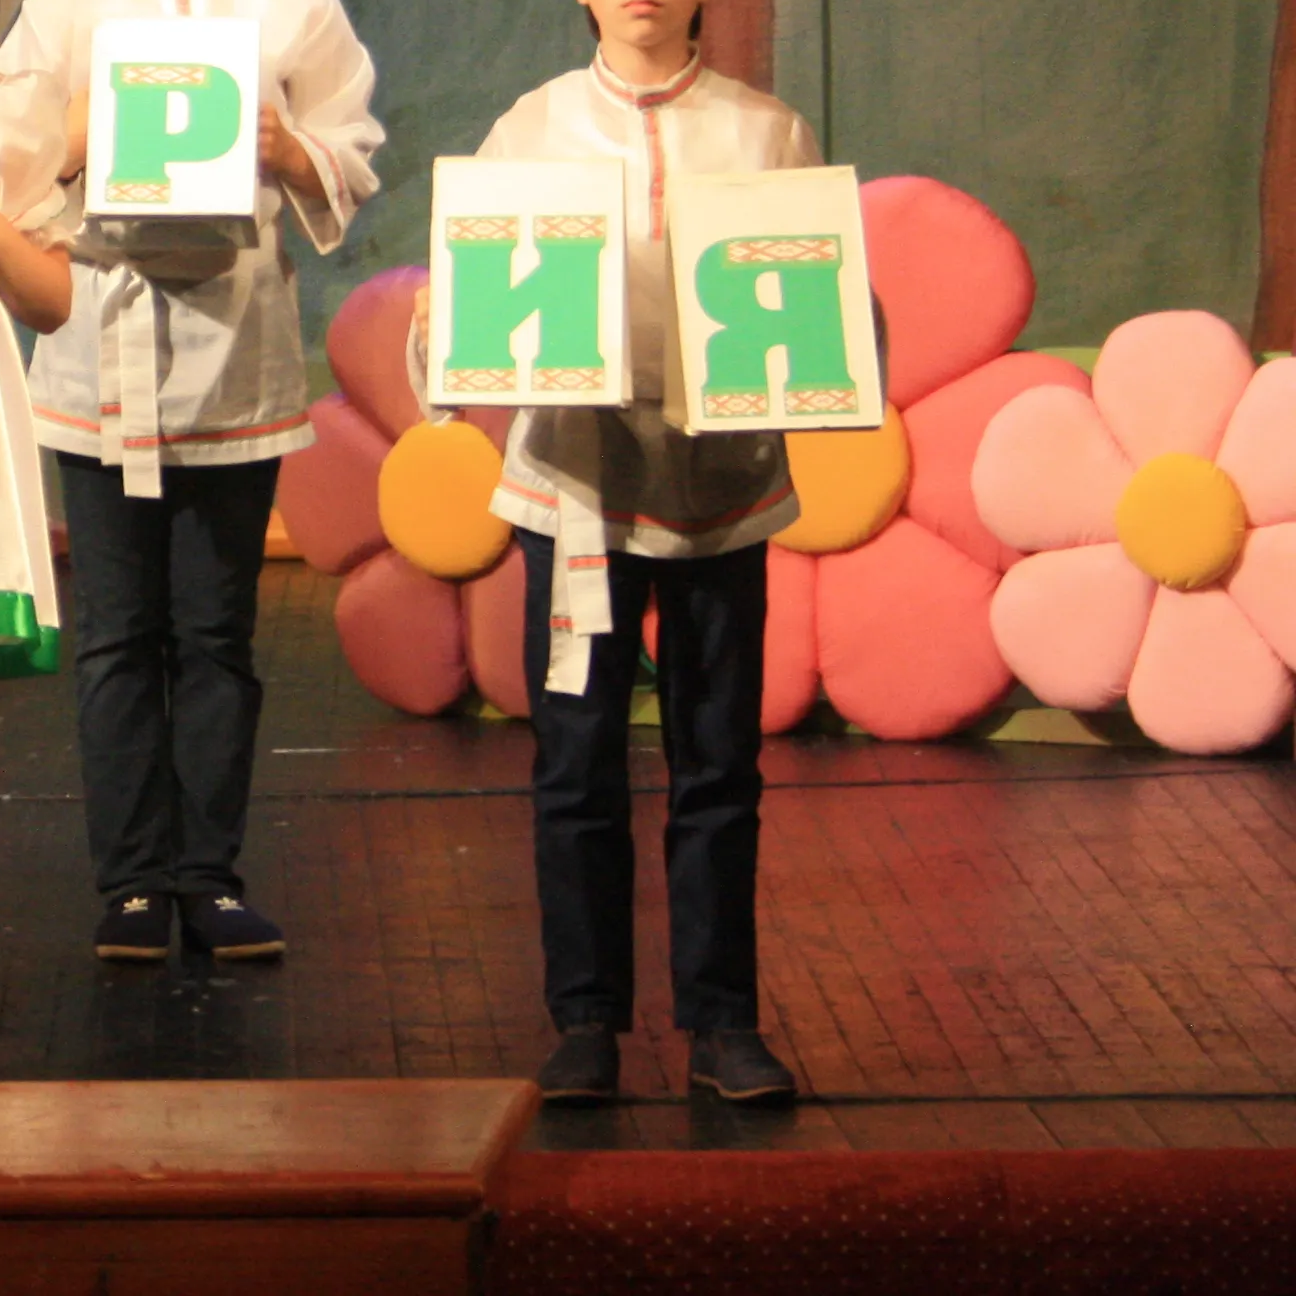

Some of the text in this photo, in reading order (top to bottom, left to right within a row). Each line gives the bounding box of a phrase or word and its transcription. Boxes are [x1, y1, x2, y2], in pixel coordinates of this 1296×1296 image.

[105, 62, 242, 204] Р
[443, 215, 609, 392] И
[694, 235, 860, 419] Я
